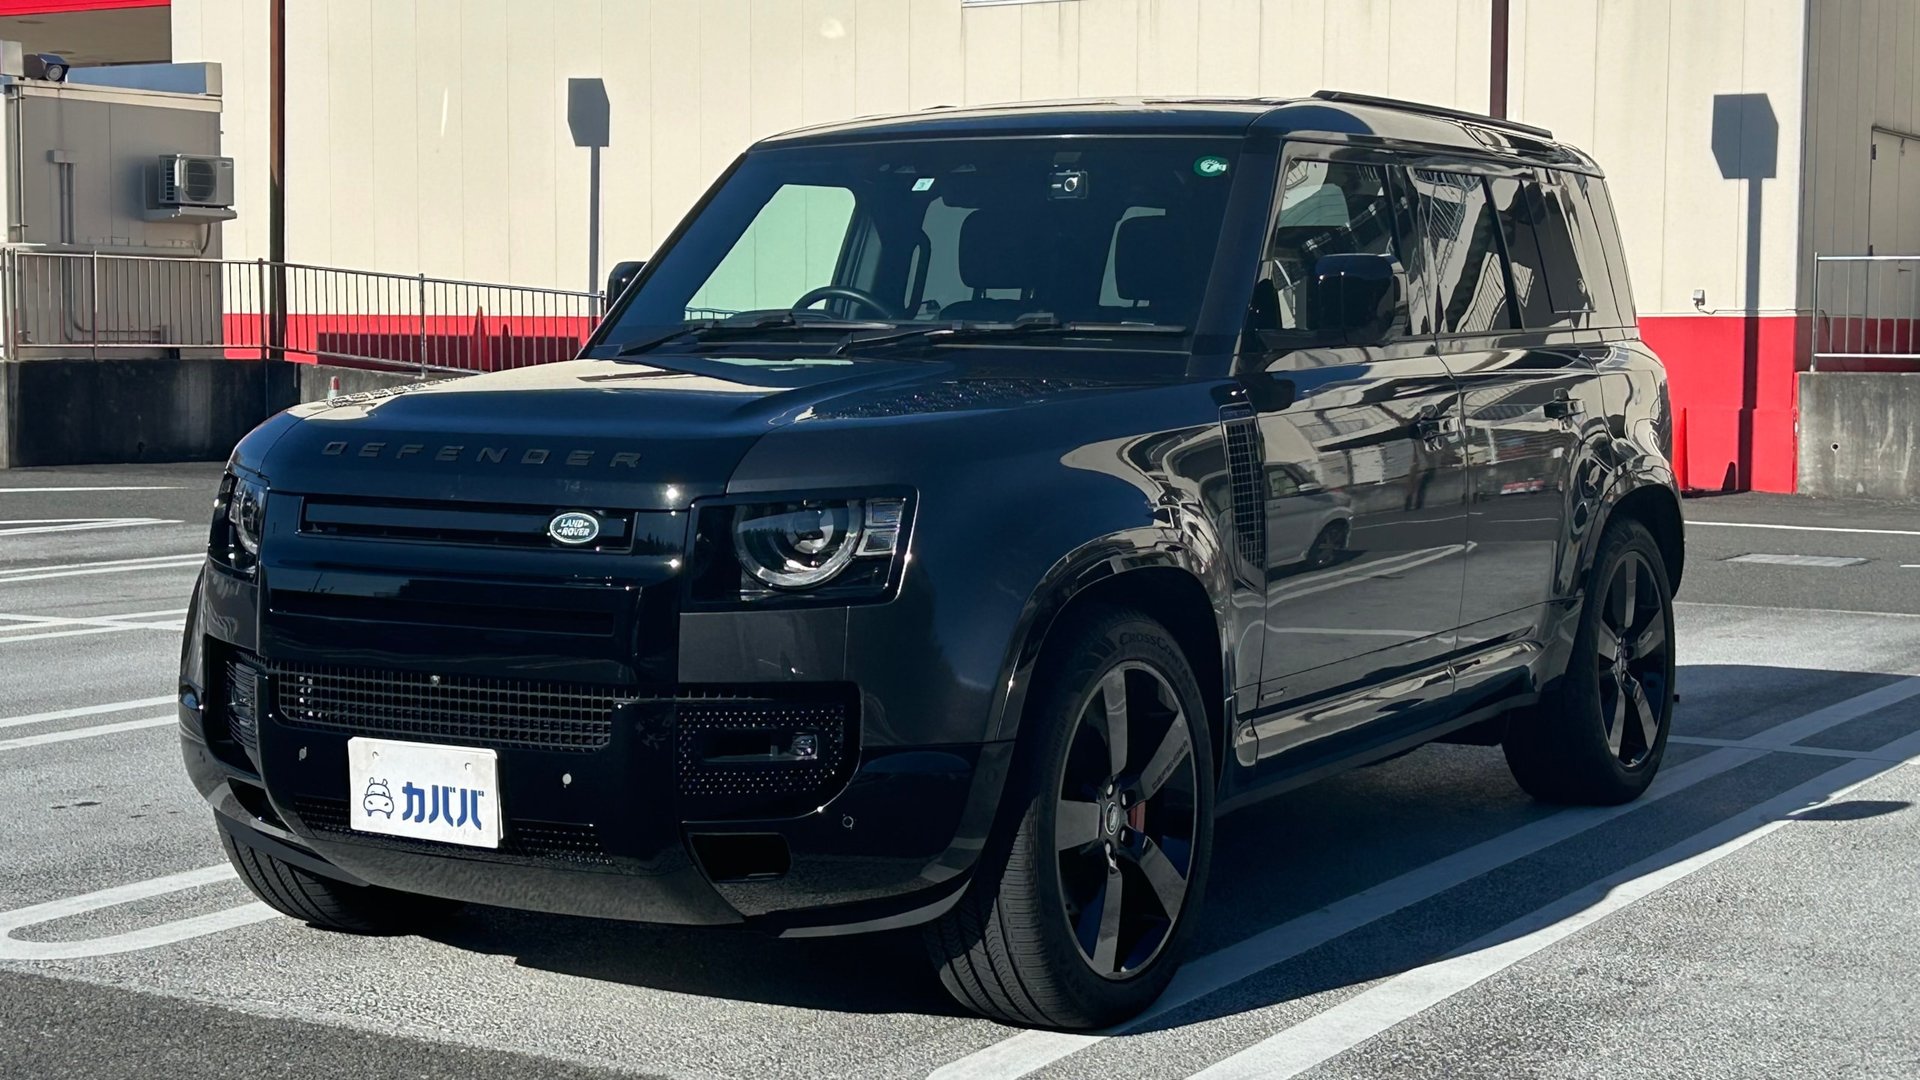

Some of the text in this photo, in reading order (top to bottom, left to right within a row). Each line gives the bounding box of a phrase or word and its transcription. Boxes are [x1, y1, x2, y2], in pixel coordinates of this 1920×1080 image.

[321, 441, 642, 469] DEFENDER
[560, 518, 585, 528] LAND
[561, 527, 590, 537] ROVER
[402, 781, 485, 831] カババ
